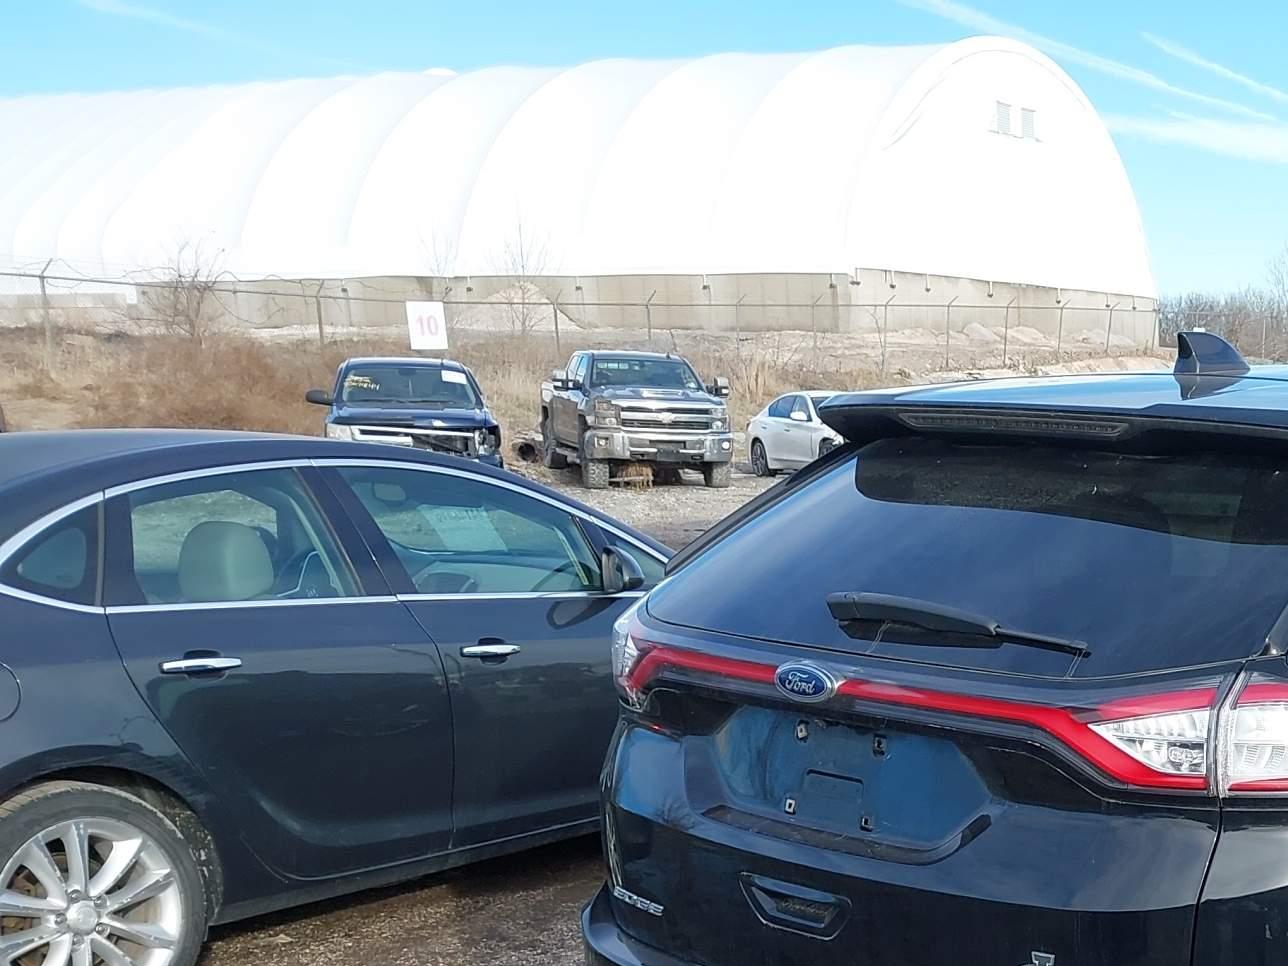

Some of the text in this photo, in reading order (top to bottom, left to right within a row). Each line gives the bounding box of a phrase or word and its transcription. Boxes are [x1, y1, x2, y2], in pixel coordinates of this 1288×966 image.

[415, 313, 439, 337] 10
[785, 671, 816, 694] Ford
[614, 886, 664, 916] EDGE
